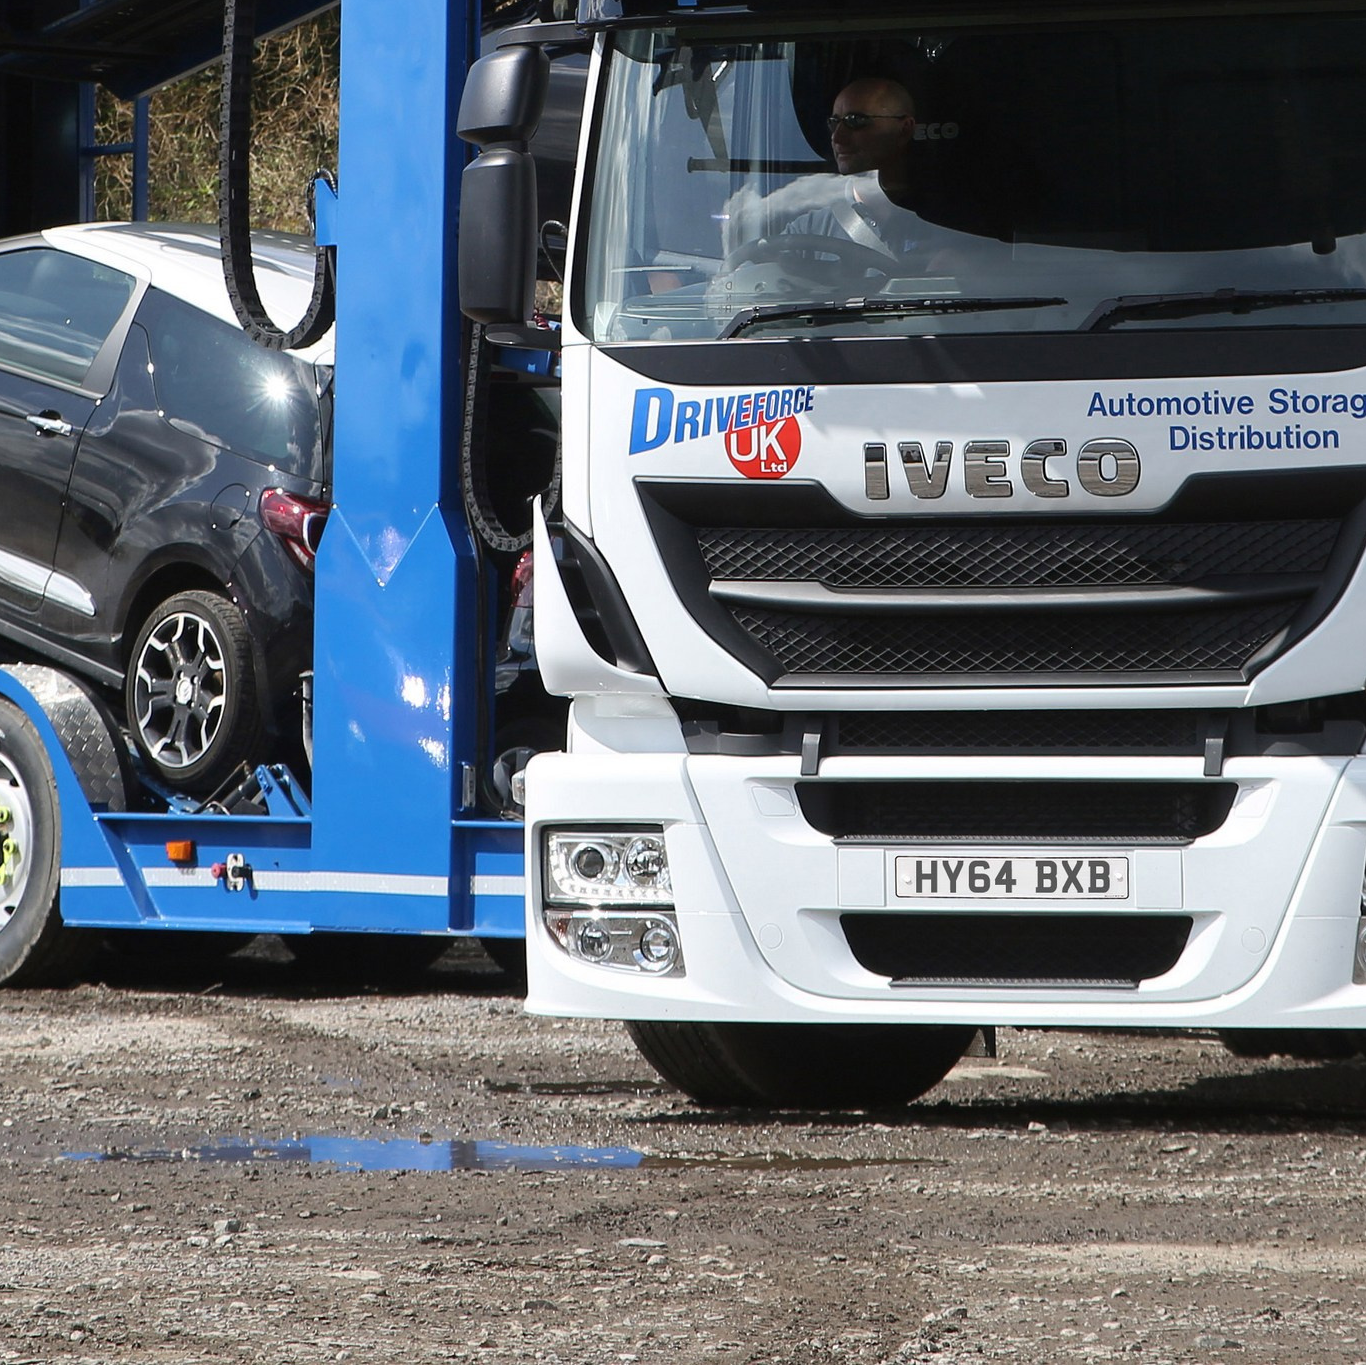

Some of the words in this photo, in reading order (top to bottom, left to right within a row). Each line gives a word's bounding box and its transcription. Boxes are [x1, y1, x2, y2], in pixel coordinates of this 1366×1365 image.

[914, 122, 959, 140] ECO
[1087, 390, 1254, 417] Automotive
[629, 386, 816, 456] DRIVEFORCE
[730, 420, 787, 462] UK
[1169, 424, 1339, 451] Distribution
[760, 462, 788, 473] Ltd
[863, 437, 1141, 500] IVECO
[915, 860, 1017, 893] HY64
[1035, 860, 1111, 893] BXB
